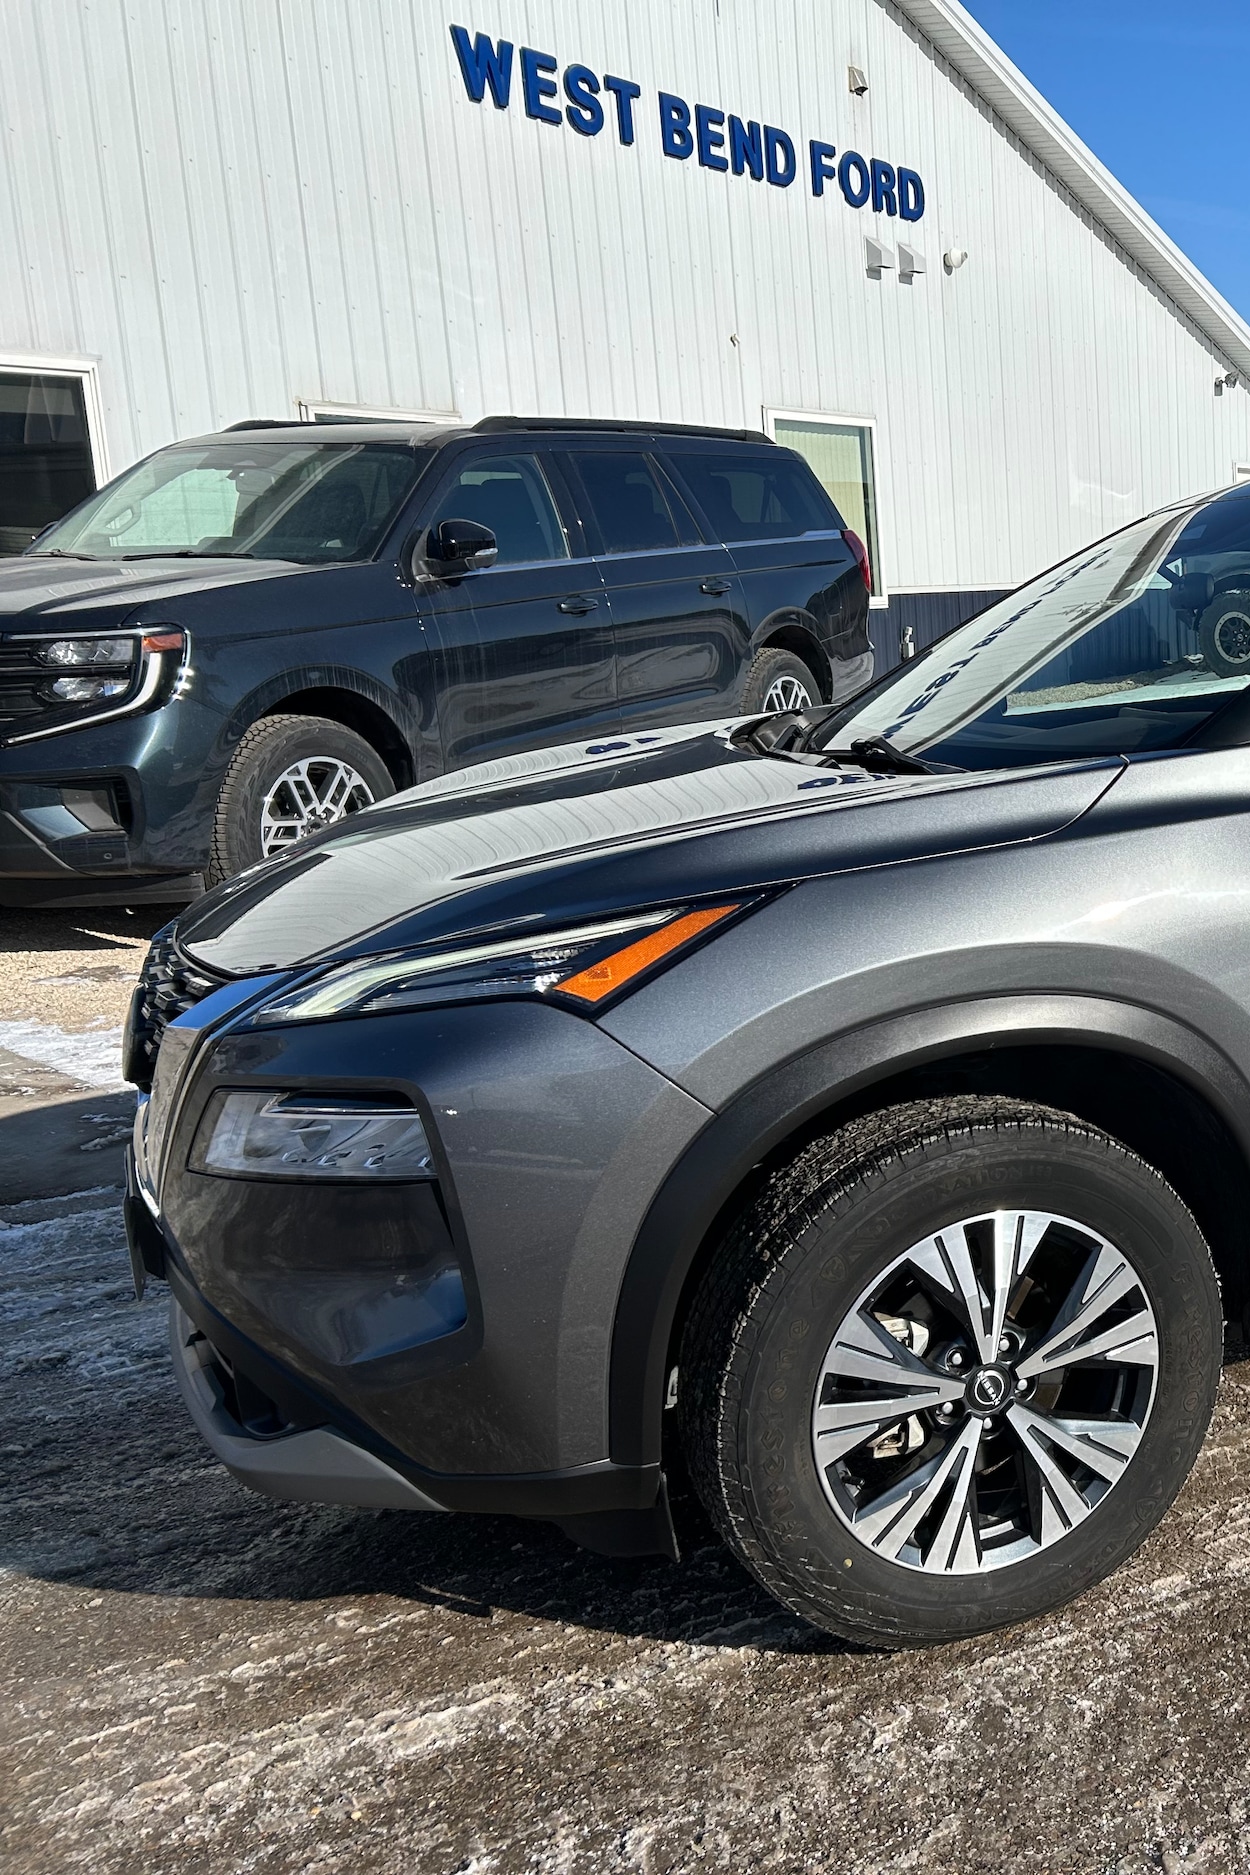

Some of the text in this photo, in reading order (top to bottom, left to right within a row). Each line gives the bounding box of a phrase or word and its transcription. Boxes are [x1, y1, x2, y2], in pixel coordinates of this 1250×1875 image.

[450, 24, 925, 222] WEST BEND FORD
[759, 1318, 811, 1546] Firestone
[977, 1370, 1001, 1406] NISSAN
